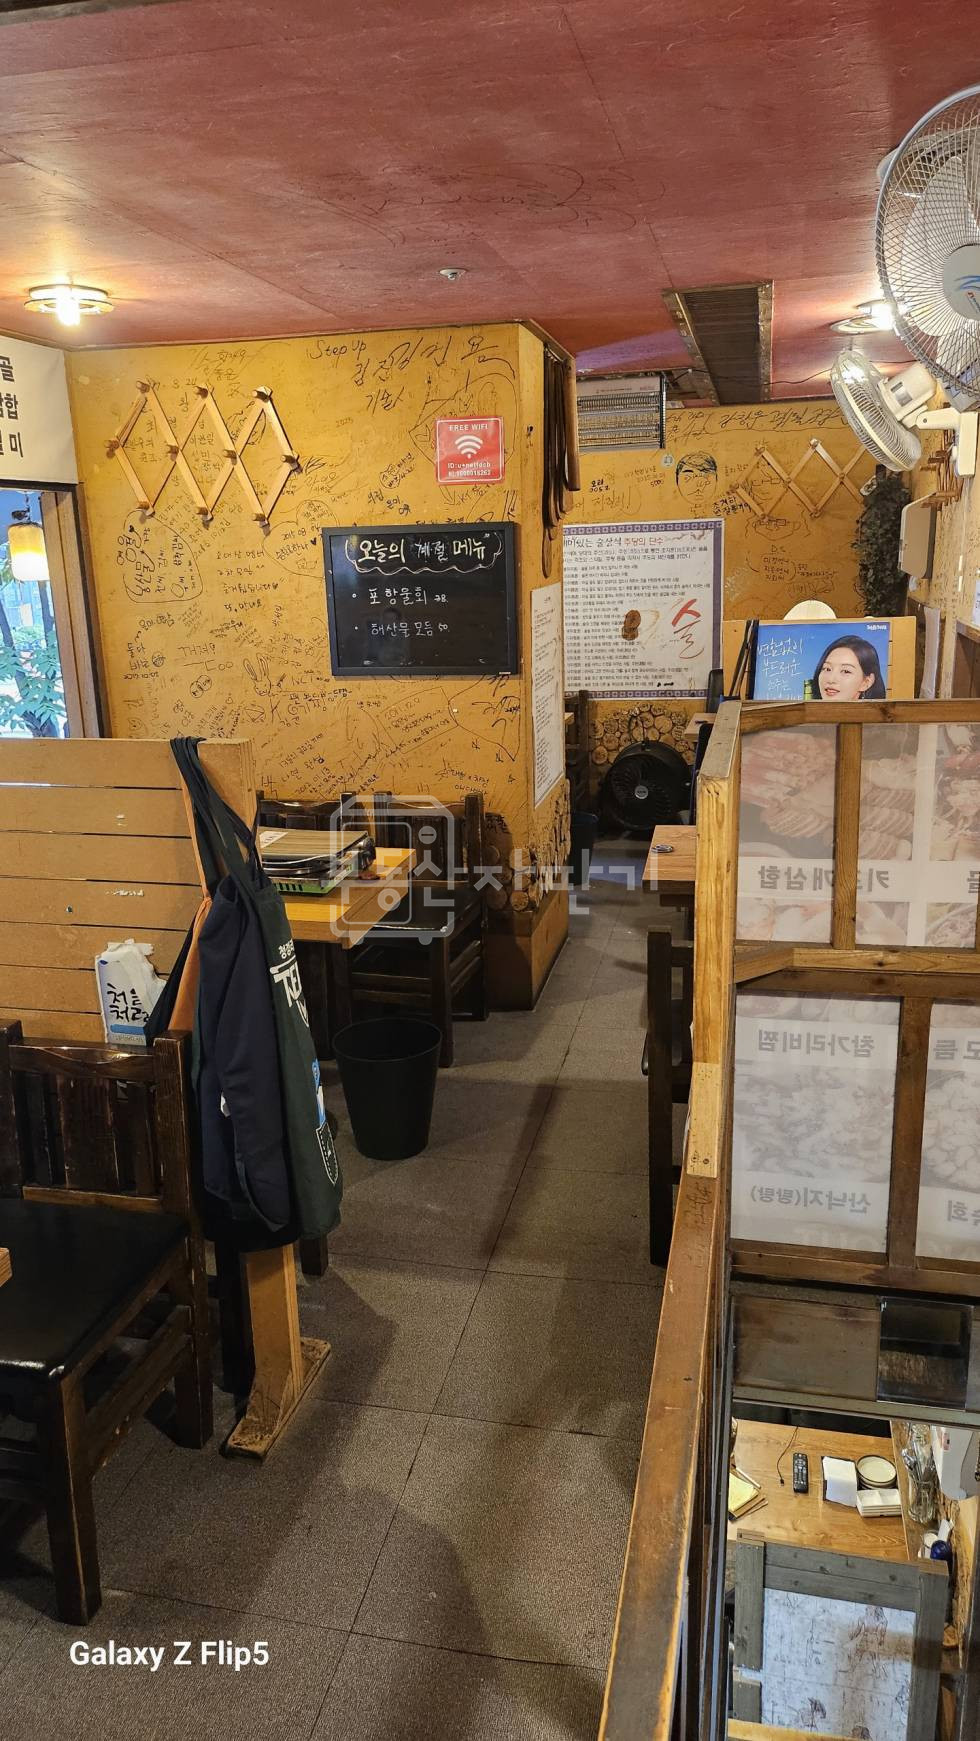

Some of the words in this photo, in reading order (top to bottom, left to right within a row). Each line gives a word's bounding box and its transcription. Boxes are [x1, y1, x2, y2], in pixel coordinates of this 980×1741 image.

[448, 424, 469, 432] FREE
[471, 423, 489, 431] WIFI
[357, 538, 405, 564] 오늘의
[415, 539, 449, 562] 계절
[453, 538, 487, 560] 메뉴
[368, 586, 427, 605] 포항물회
[371, 622, 410, 638] 해산물
[413, 620, 433, 637] 모듬
